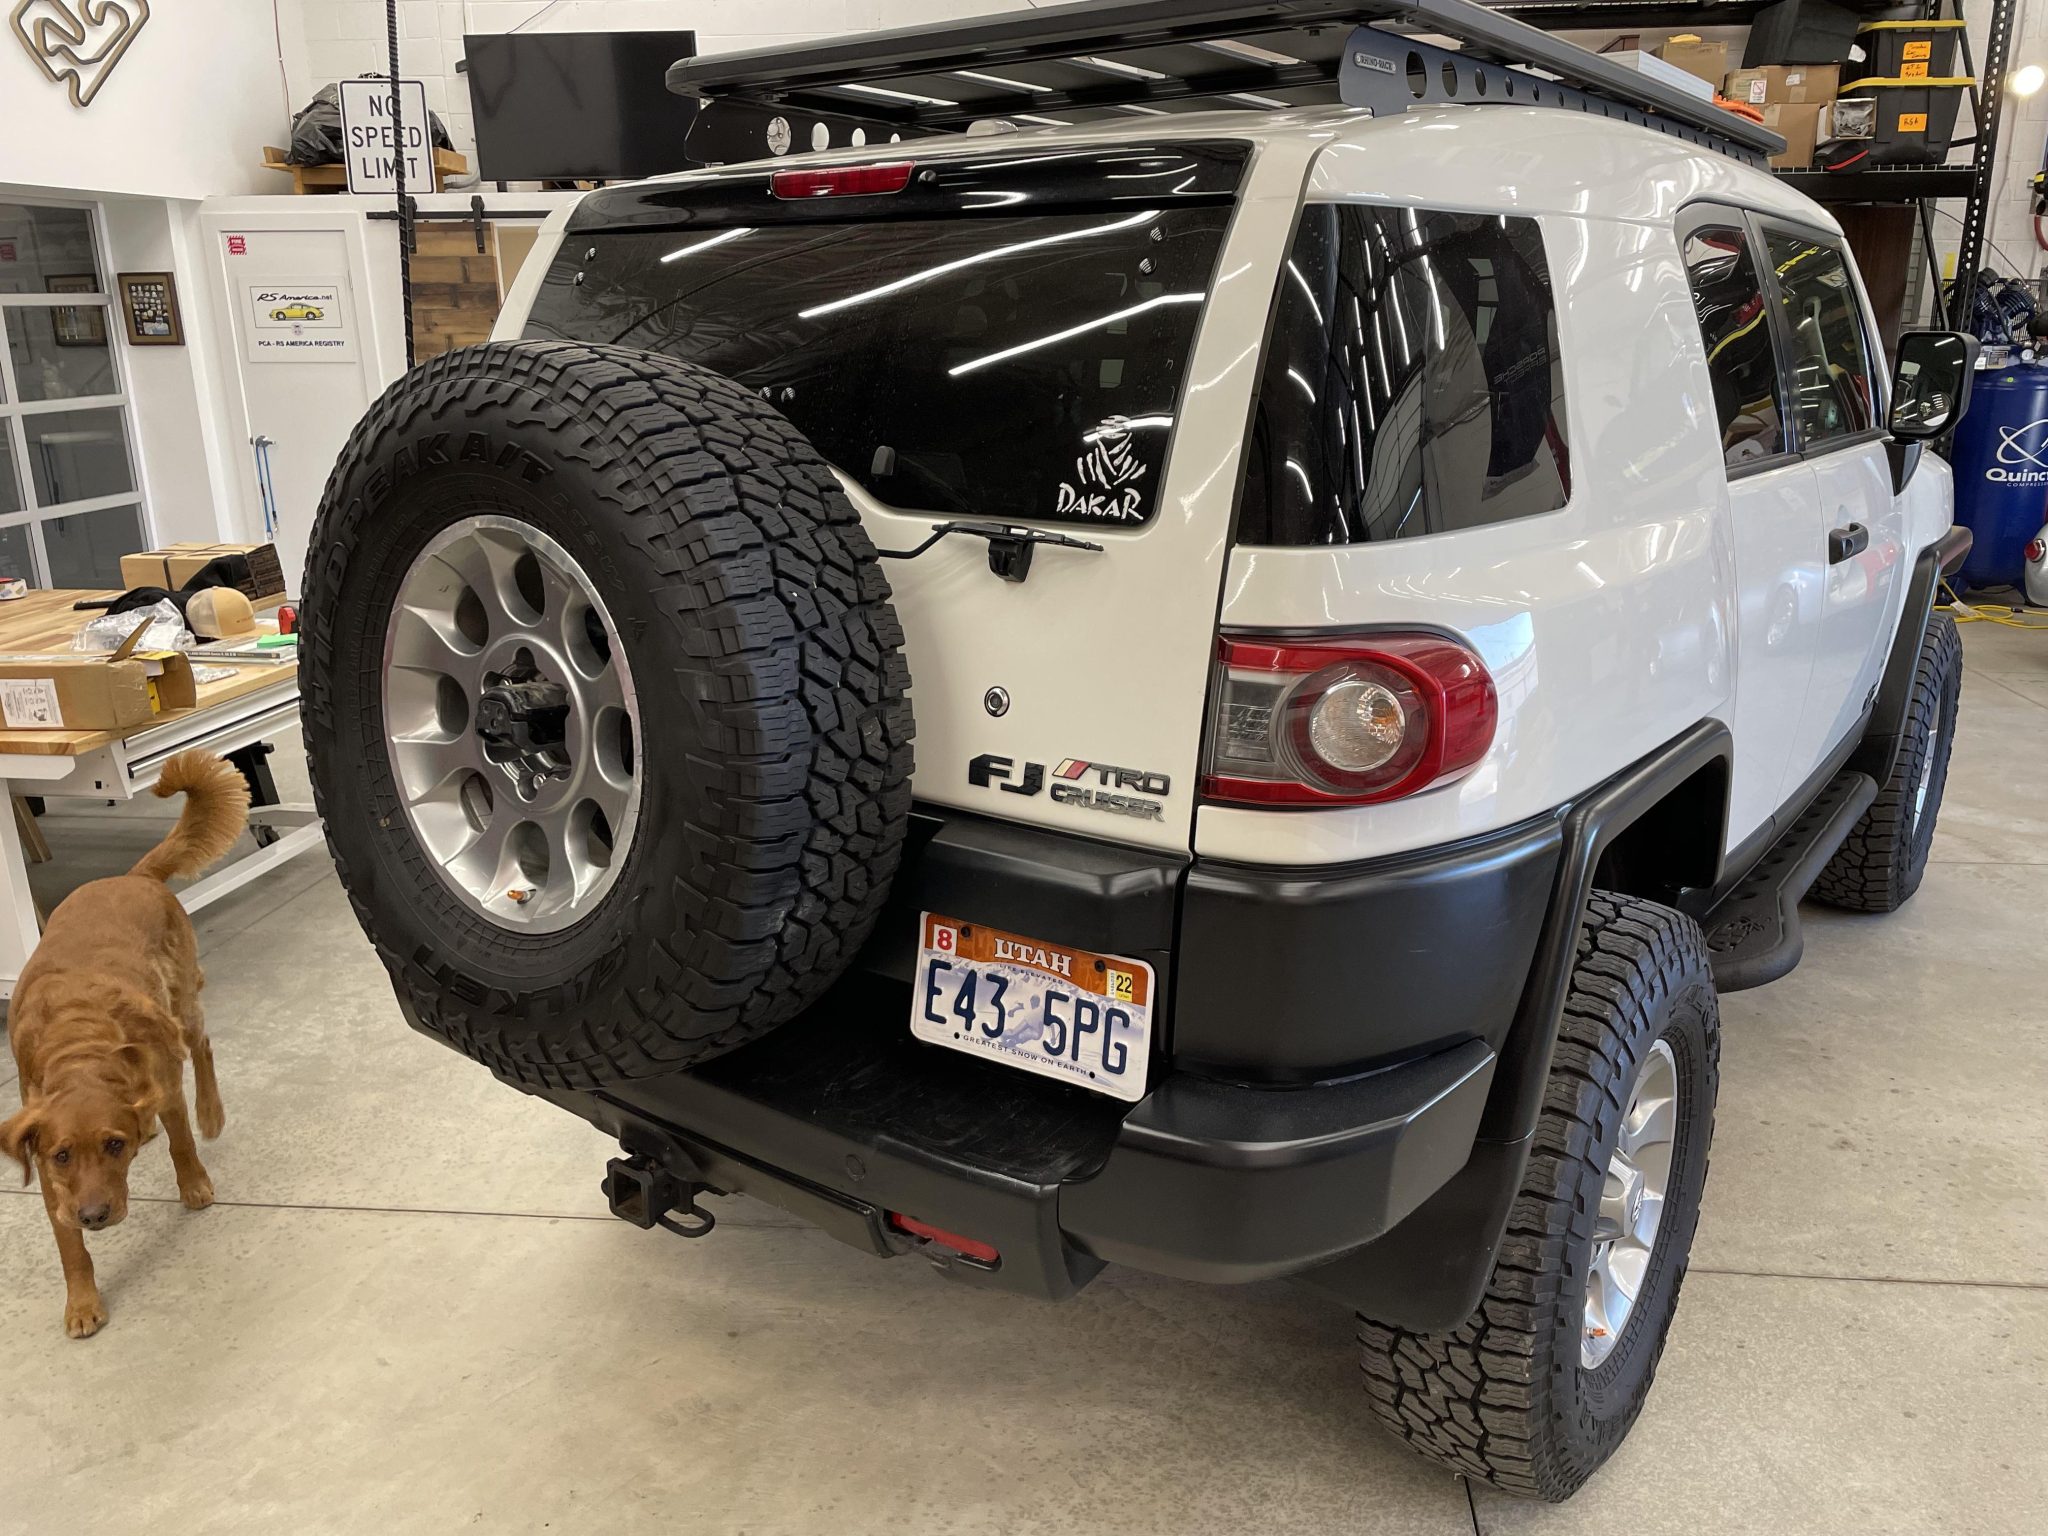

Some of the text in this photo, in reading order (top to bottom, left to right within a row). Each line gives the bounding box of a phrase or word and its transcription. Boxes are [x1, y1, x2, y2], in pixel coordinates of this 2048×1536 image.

[362, 157, 418, 179] LIMT
[257, 293, 279, 302] RS
[1985, 467, 2048, 482] Quinc
[969, 754, 1046, 796] FJ
[1088, 761, 1170, 796] TRD
[1050, 783, 1165, 822] CRUISER
[937, 929, 953, 951] 8
[994, 938, 1072, 977] UTAH
[1020, 969, 1063, 985] ELEVATED
[1116, 974, 1132, 994] 22
[924, 959, 1130, 1075] E43 5PG
[963, 1034, 1087, 1075] GREATEST SNOW ON EARTH
